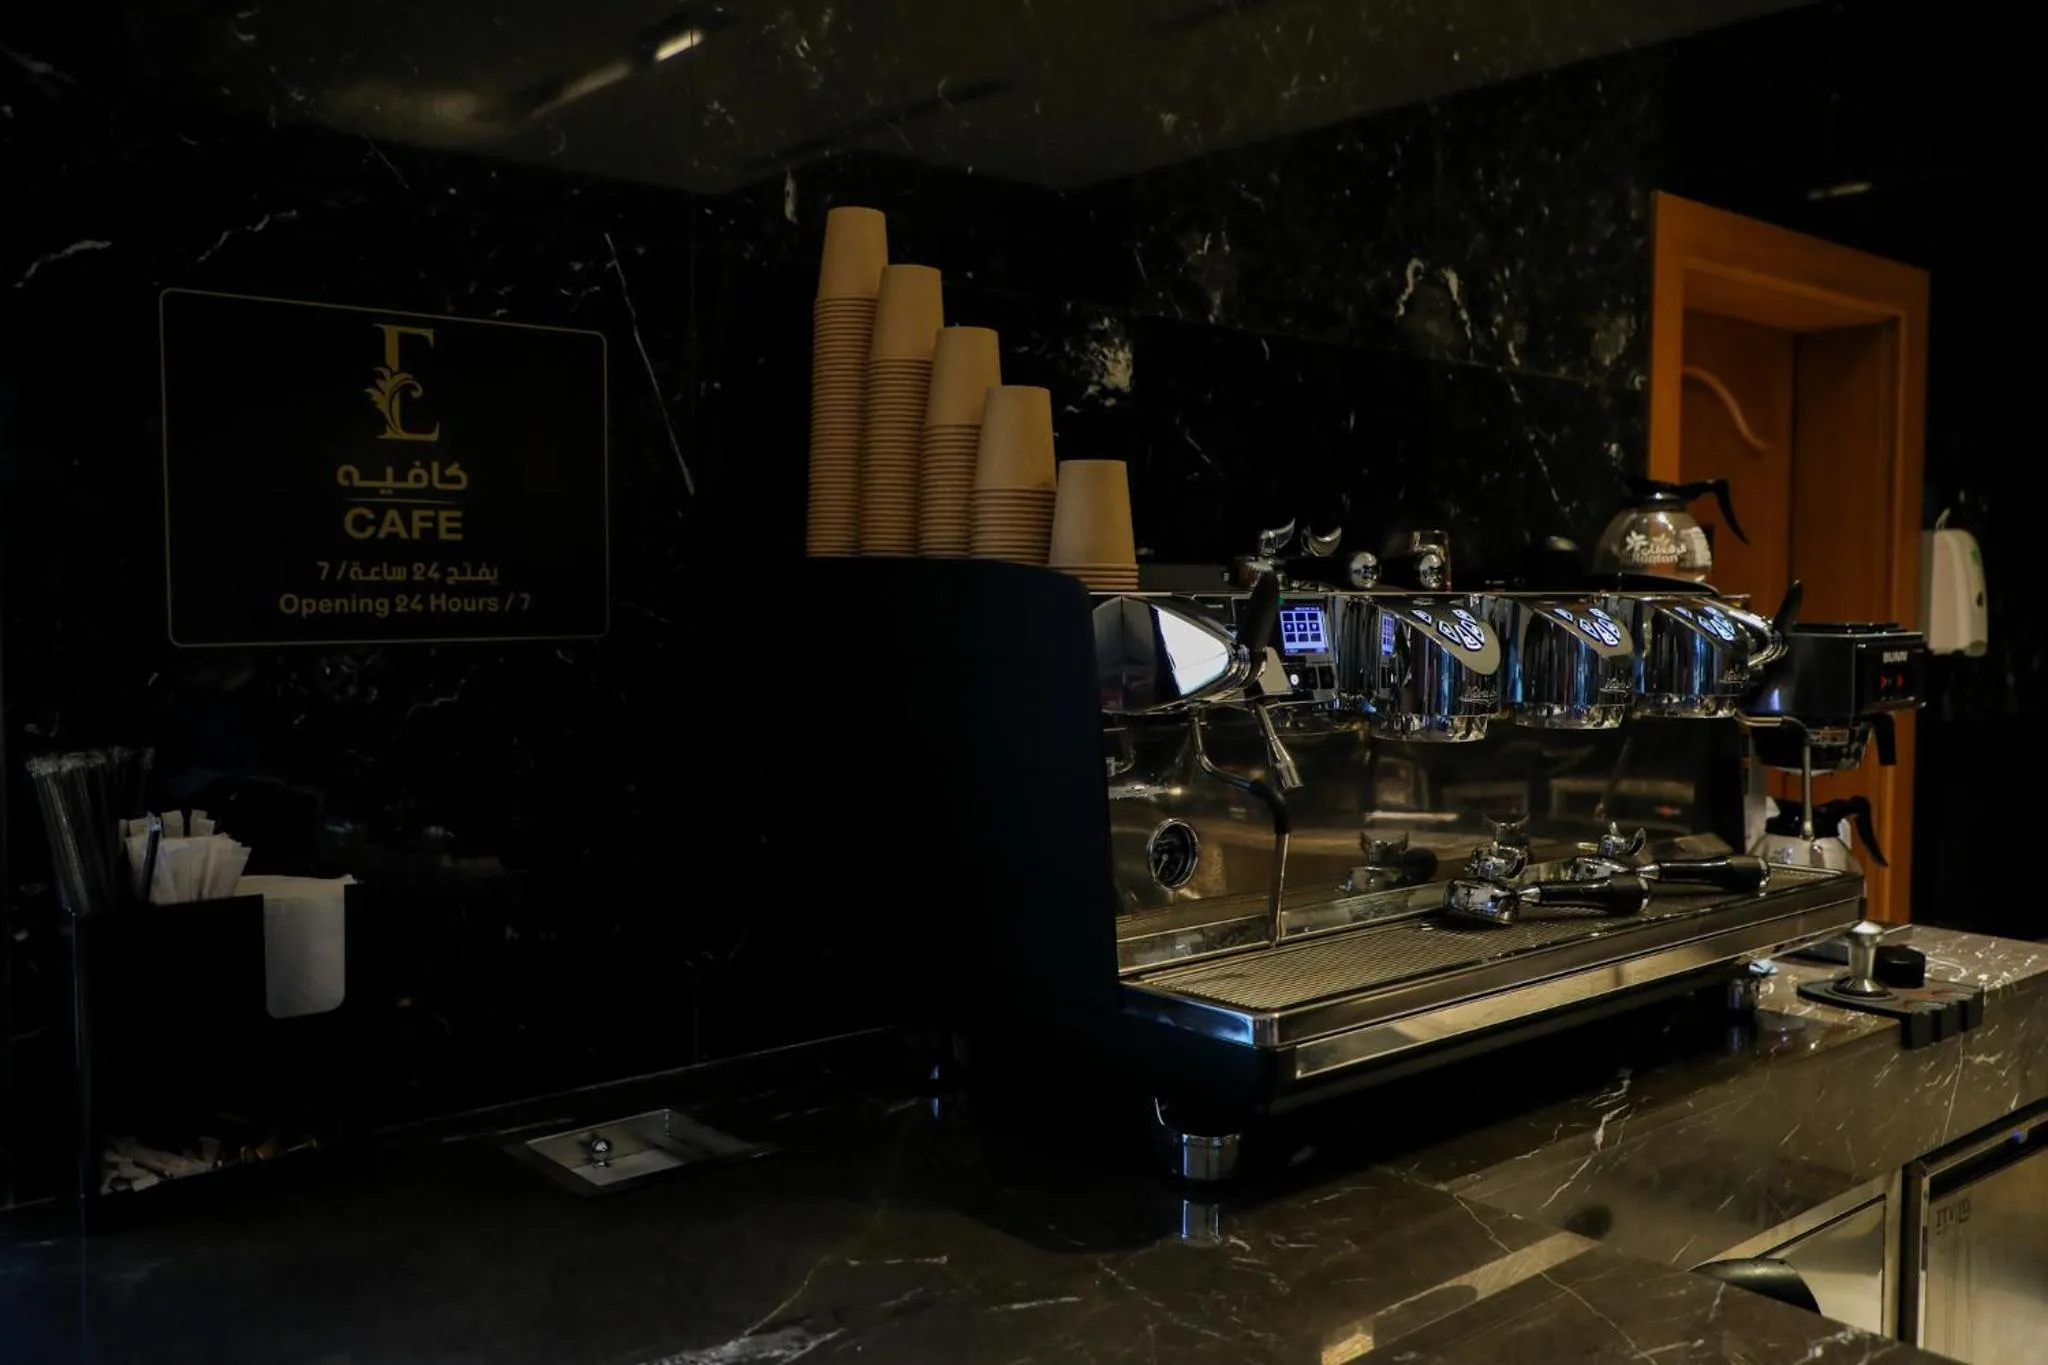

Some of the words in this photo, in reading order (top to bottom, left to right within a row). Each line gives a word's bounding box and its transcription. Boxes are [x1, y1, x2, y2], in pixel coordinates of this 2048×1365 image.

[336, 460, 469, 495] كافيه
[343, 506, 464, 541] CAFE
[412, 561, 441, 581] 24
[279, 592, 390, 618] Opening
[394, 593, 424, 613] 24
[429, 592, 499, 613] Hours
